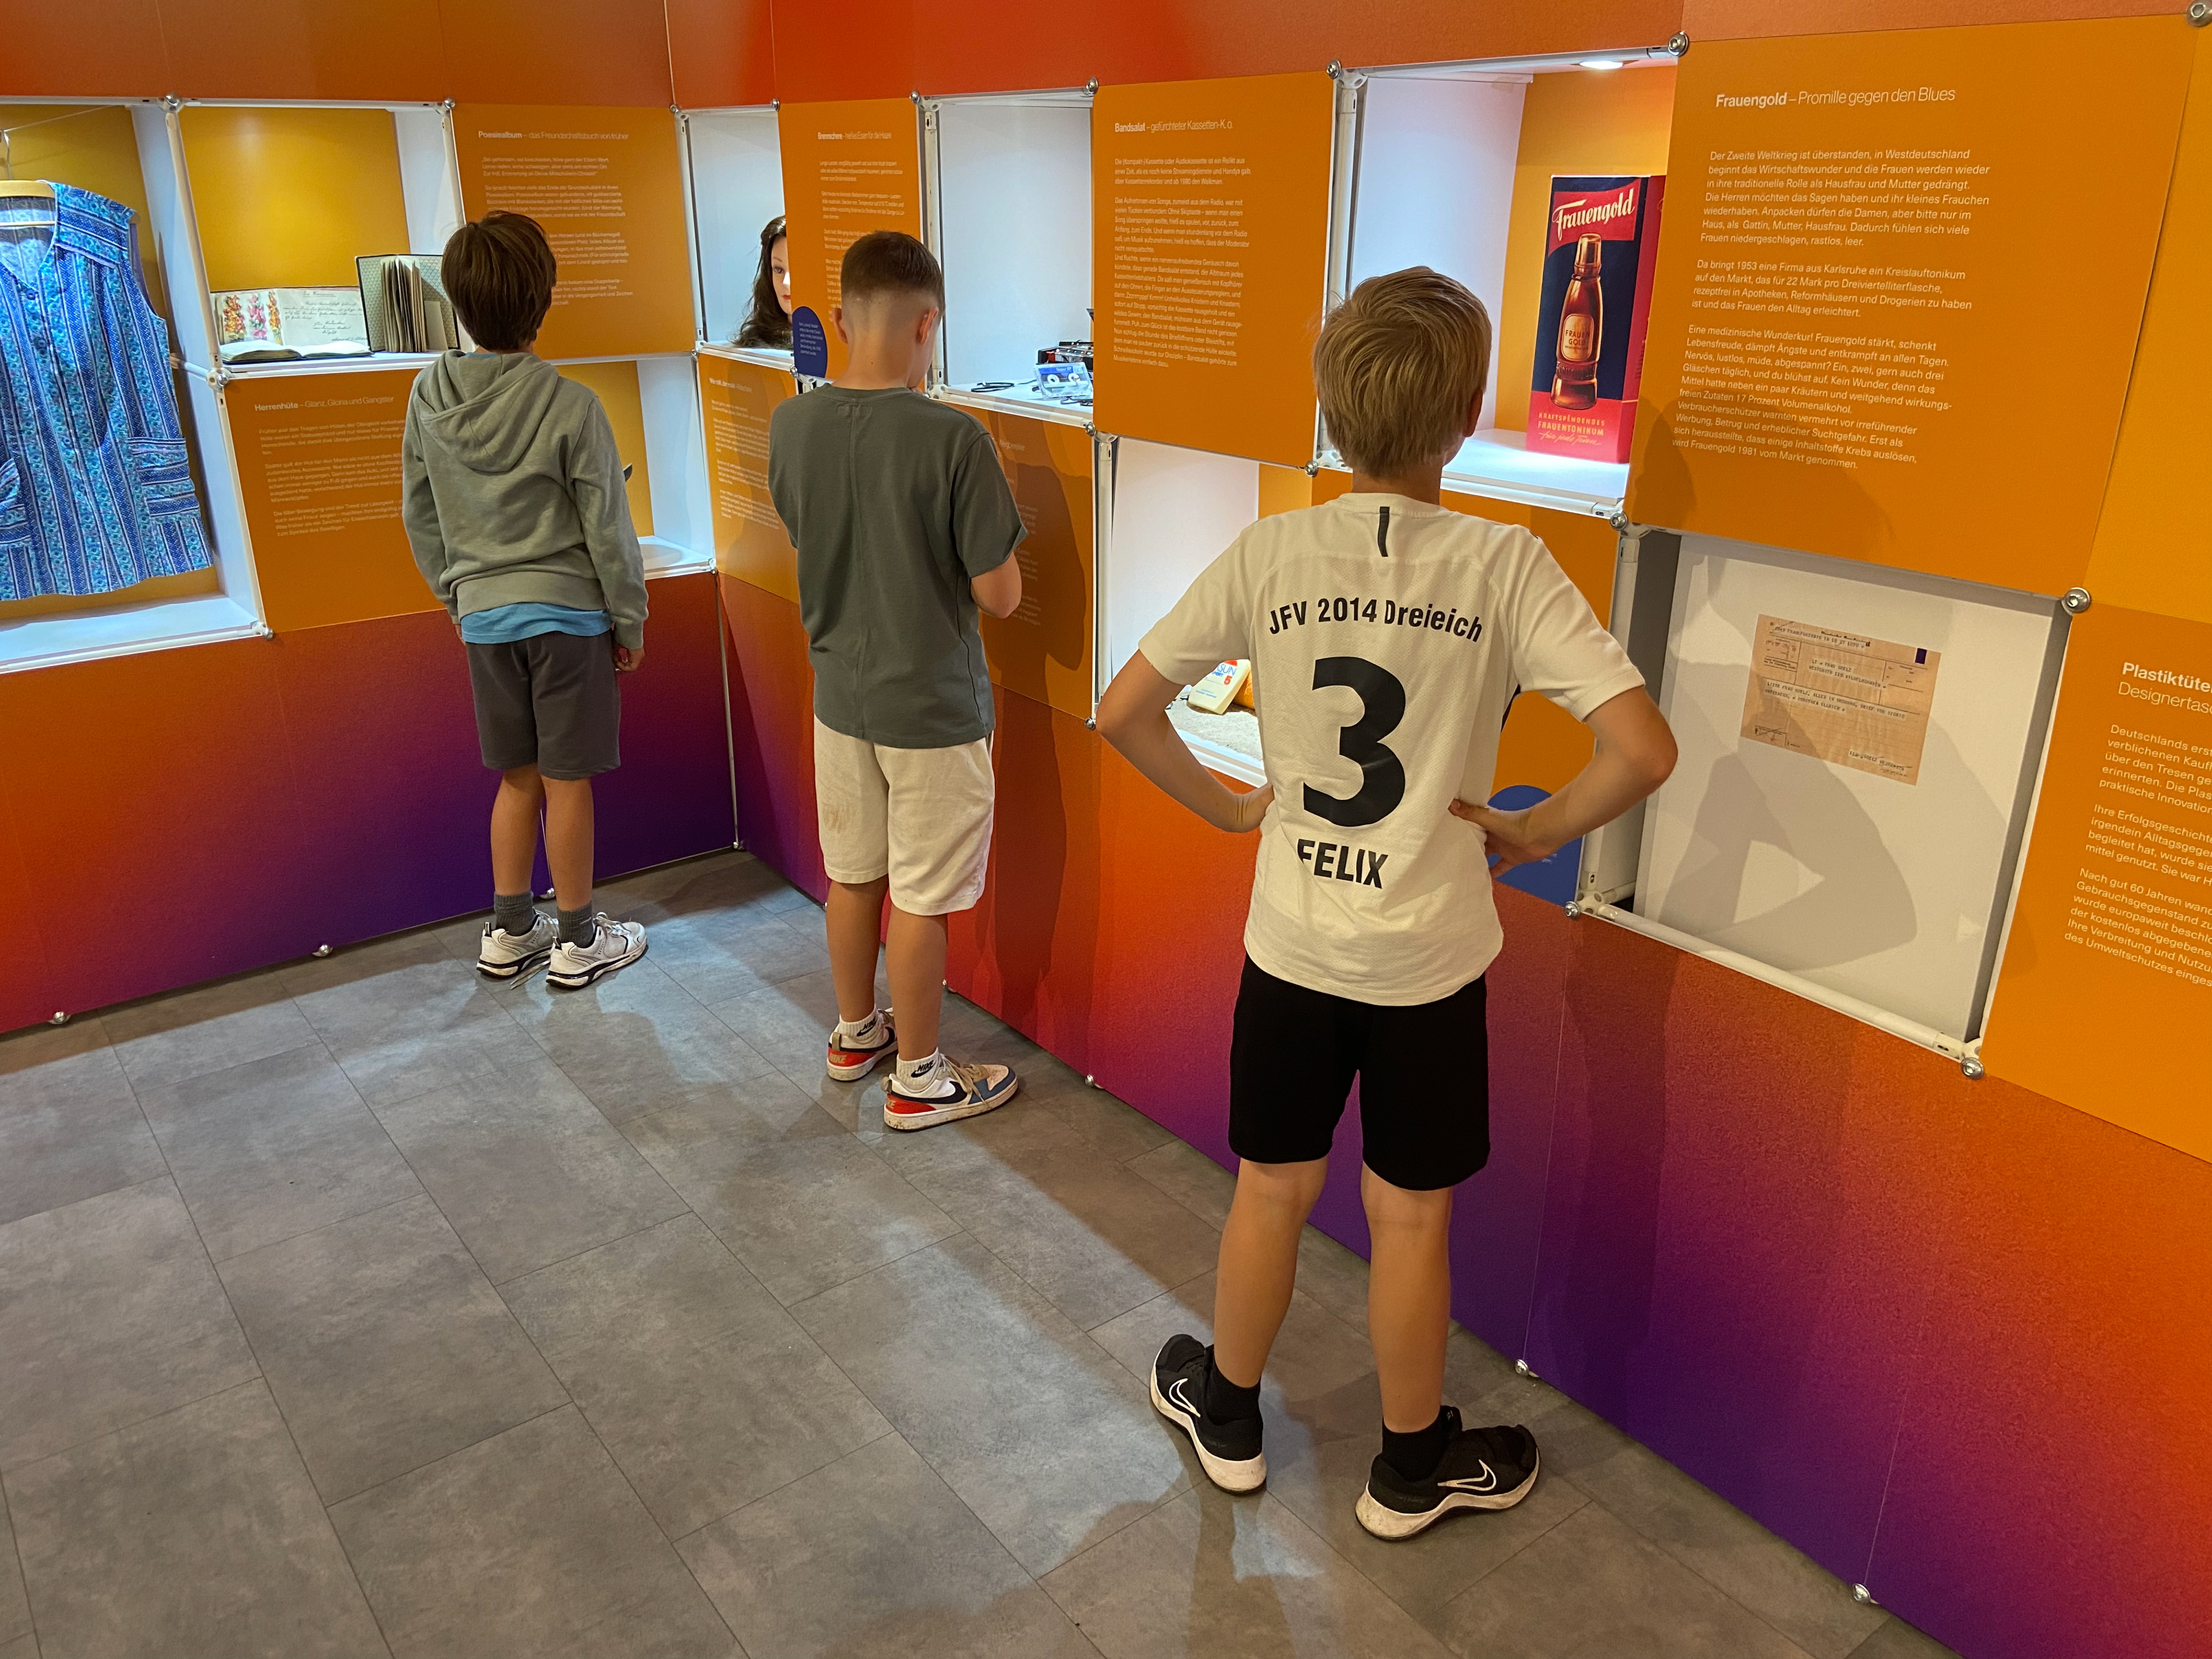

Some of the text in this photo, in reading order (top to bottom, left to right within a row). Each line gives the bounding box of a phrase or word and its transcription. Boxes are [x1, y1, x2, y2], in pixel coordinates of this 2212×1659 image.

[1716, 92, 1787, 108] Frauengold
[1798, 90, 1846, 104] Promille
[1849, 92, 1888, 106] gegen
[1891, 88, 1915, 102] den
[1918, 87, 1955, 101] Blues
[1115, 122, 1145, 132] Bandsalat
[1710, 149, 1970, 161] Der Zweite Weltkrieg ist überstanden, in Westdeutschland
[1709, 164, 1990, 176] beginnt das Wirtschaftswunder und die Frauen werden wieder
[1716, 179, 1732, 188] ihre
[1734, 179, 1785, 188] traditionelle
[1786, 179, 1808, 188] Rolle
[1810, 179, 1823, 188] als
[1825, 179, 1866, 188] Hausfrau
[1868, 179, 1887, 188] und
[1888, 179, 1921, 188] Mutter
[1923, 179, 1969, 191] gedrängt.
[1706, 192, 1989, 204] Die Herren möchten das Sagen haben und ihr kleines Frauchen
[1551, 187, 1635, 241] Frauengold
[1703, 206, 1759, 215] wiederhaben.
[1762, 206, 1804, 218] Anpacken
[1807, 207, 1836, 217] dürfen
[1838, 208, 1852, 217] die
[1854, 208, 1889, 219] Damen,
[1892, 209, 1914, 218] aber
[1916, 209, 1938, 219] bitte
[1959, 210, 1971, 219] im
[1702, 219, 1969, 234] Haus, als Gattin, Mutter, Hausfrau. Dadurch fühlen sich viele
[1700, 233, 1863, 246] Frauen niedergeschlagen, rastlos, leer.
[1565, 329, 1590, 338] FRAUEN
[255, 402, 298, 411] Herrenhüte
[1537, 421, 1604, 436] FRAUENTONIKUM
[1538, 412, 1605, 426] KRAFTSPENDENDES
[1270, 598, 1482, 642] JFV 2014 Dreieich
[1224, 675, 1233, 685] 5
[2123, 662, 2212, 693] Plastiktüte
[1304, 657, 1406, 827] 3
[2111, 725, 2188, 750] Deutschlands
[2108, 740, 2180, 763] verblichenen
[2105, 753, 2194, 781] über den Tresen
[2100, 780, 2154, 799] praktische
[2102, 767, 2161, 787] erinnerten.
[2166, 781, 2184, 793] Die
[2094, 804, 2115, 816] Ihre
[2091, 817, 2141, 838] irgendein
[2088, 830, 2212, 872] begleitet hat, wurde sie
[1298, 839, 1388, 889] FELIX
[2086, 844, 2201, 882] mittel genutzt. Sie war
[2080, 868, 2107, 883] Nach
[2109, 879, 2127, 889] gut
[2130, 884, 2143, 894] 60
[2145, 888, 2181, 906] Jahren
[2074, 896, 2106, 910] wurde
[2109, 907, 2169, 930] europaweit
[2077, 881, 2199, 925] Gebrauchsgegenstand
[2071, 907, 2212, 958] der kostenlos abgegebene
[2065, 933, 2083, 944] des
[2086, 938, 2173, 974] Umweltschutzes
[2068, 918, 2212, 973] Ihre Verbreitung und Nutzu
[917, 1060, 934, 1072] NIKE
